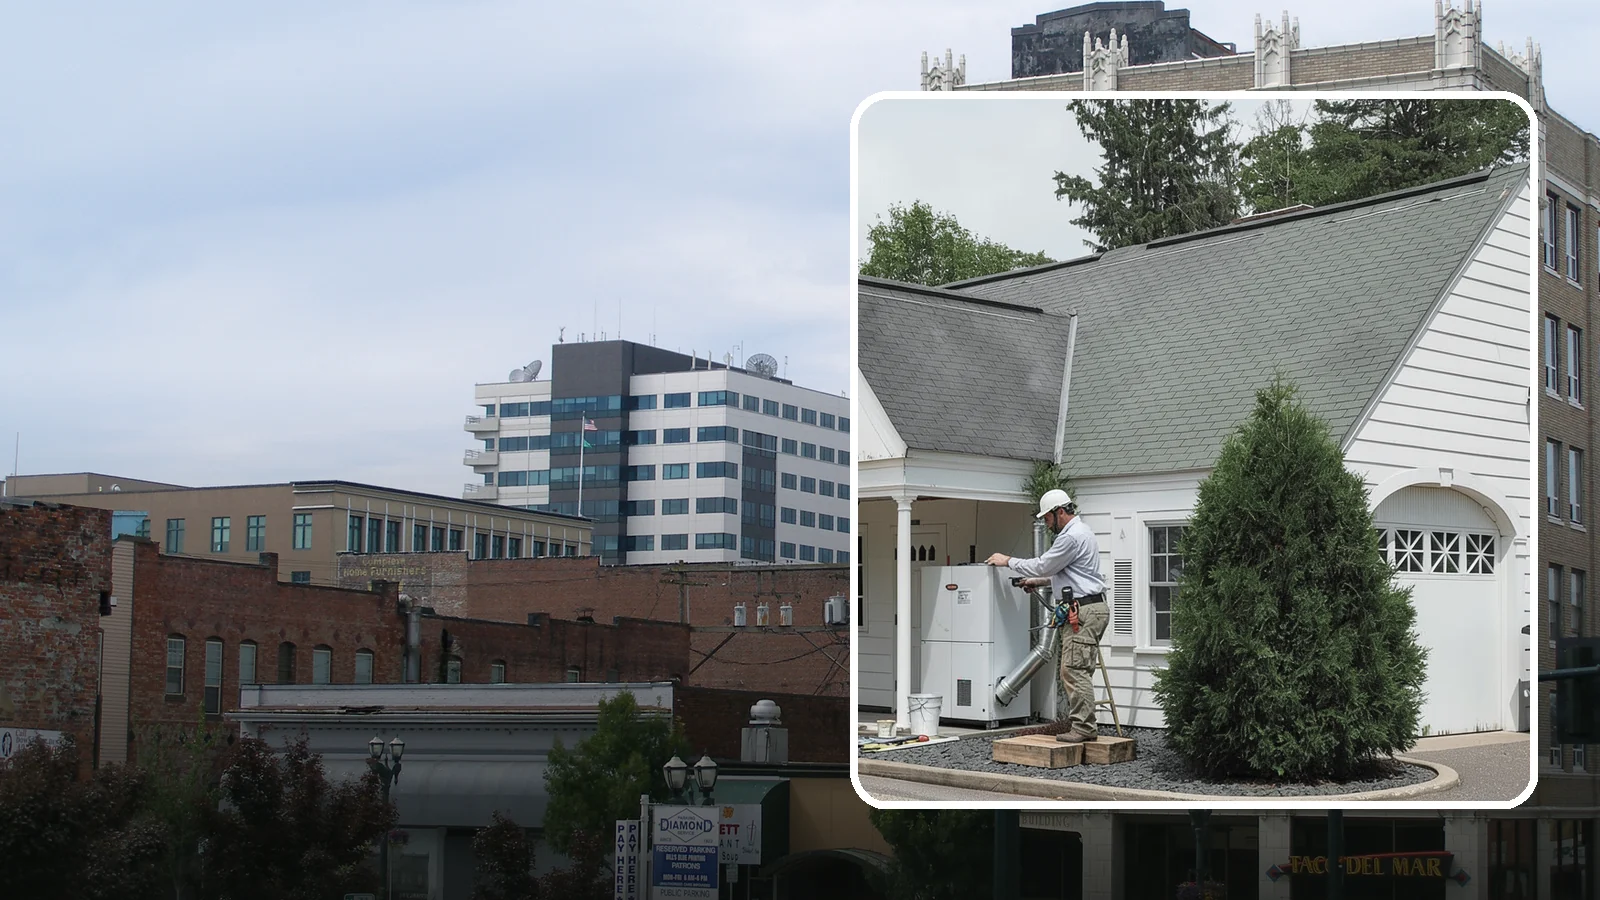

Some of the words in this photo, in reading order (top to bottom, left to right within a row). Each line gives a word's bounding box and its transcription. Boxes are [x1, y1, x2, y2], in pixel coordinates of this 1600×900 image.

[343, 568, 368, 577] Home
[370, 566, 427, 576] Furnishers
[660, 818, 713, 832] DIAMOND
[1022, 815, 1070, 828] BUILDING
[617, 825, 625, 852] PAY
[628, 825, 637, 852] PAY
[656, 845, 688, 853] RESERVED
[689, 846, 716, 854] PARKING
[722, 851, 739, 863] Soup
[671, 861, 701, 870] PATRONS
[1289, 855, 1329, 874] TAC
[1345, 856, 1385, 876] DEL
[1392, 857, 1442, 877] MAR
[617, 856, 625, 893] HERE
[628, 856, 636, 893] HERE
[660, 888, 682, 897] PUBLIC
[683, 889, 710, 898] PARKING
